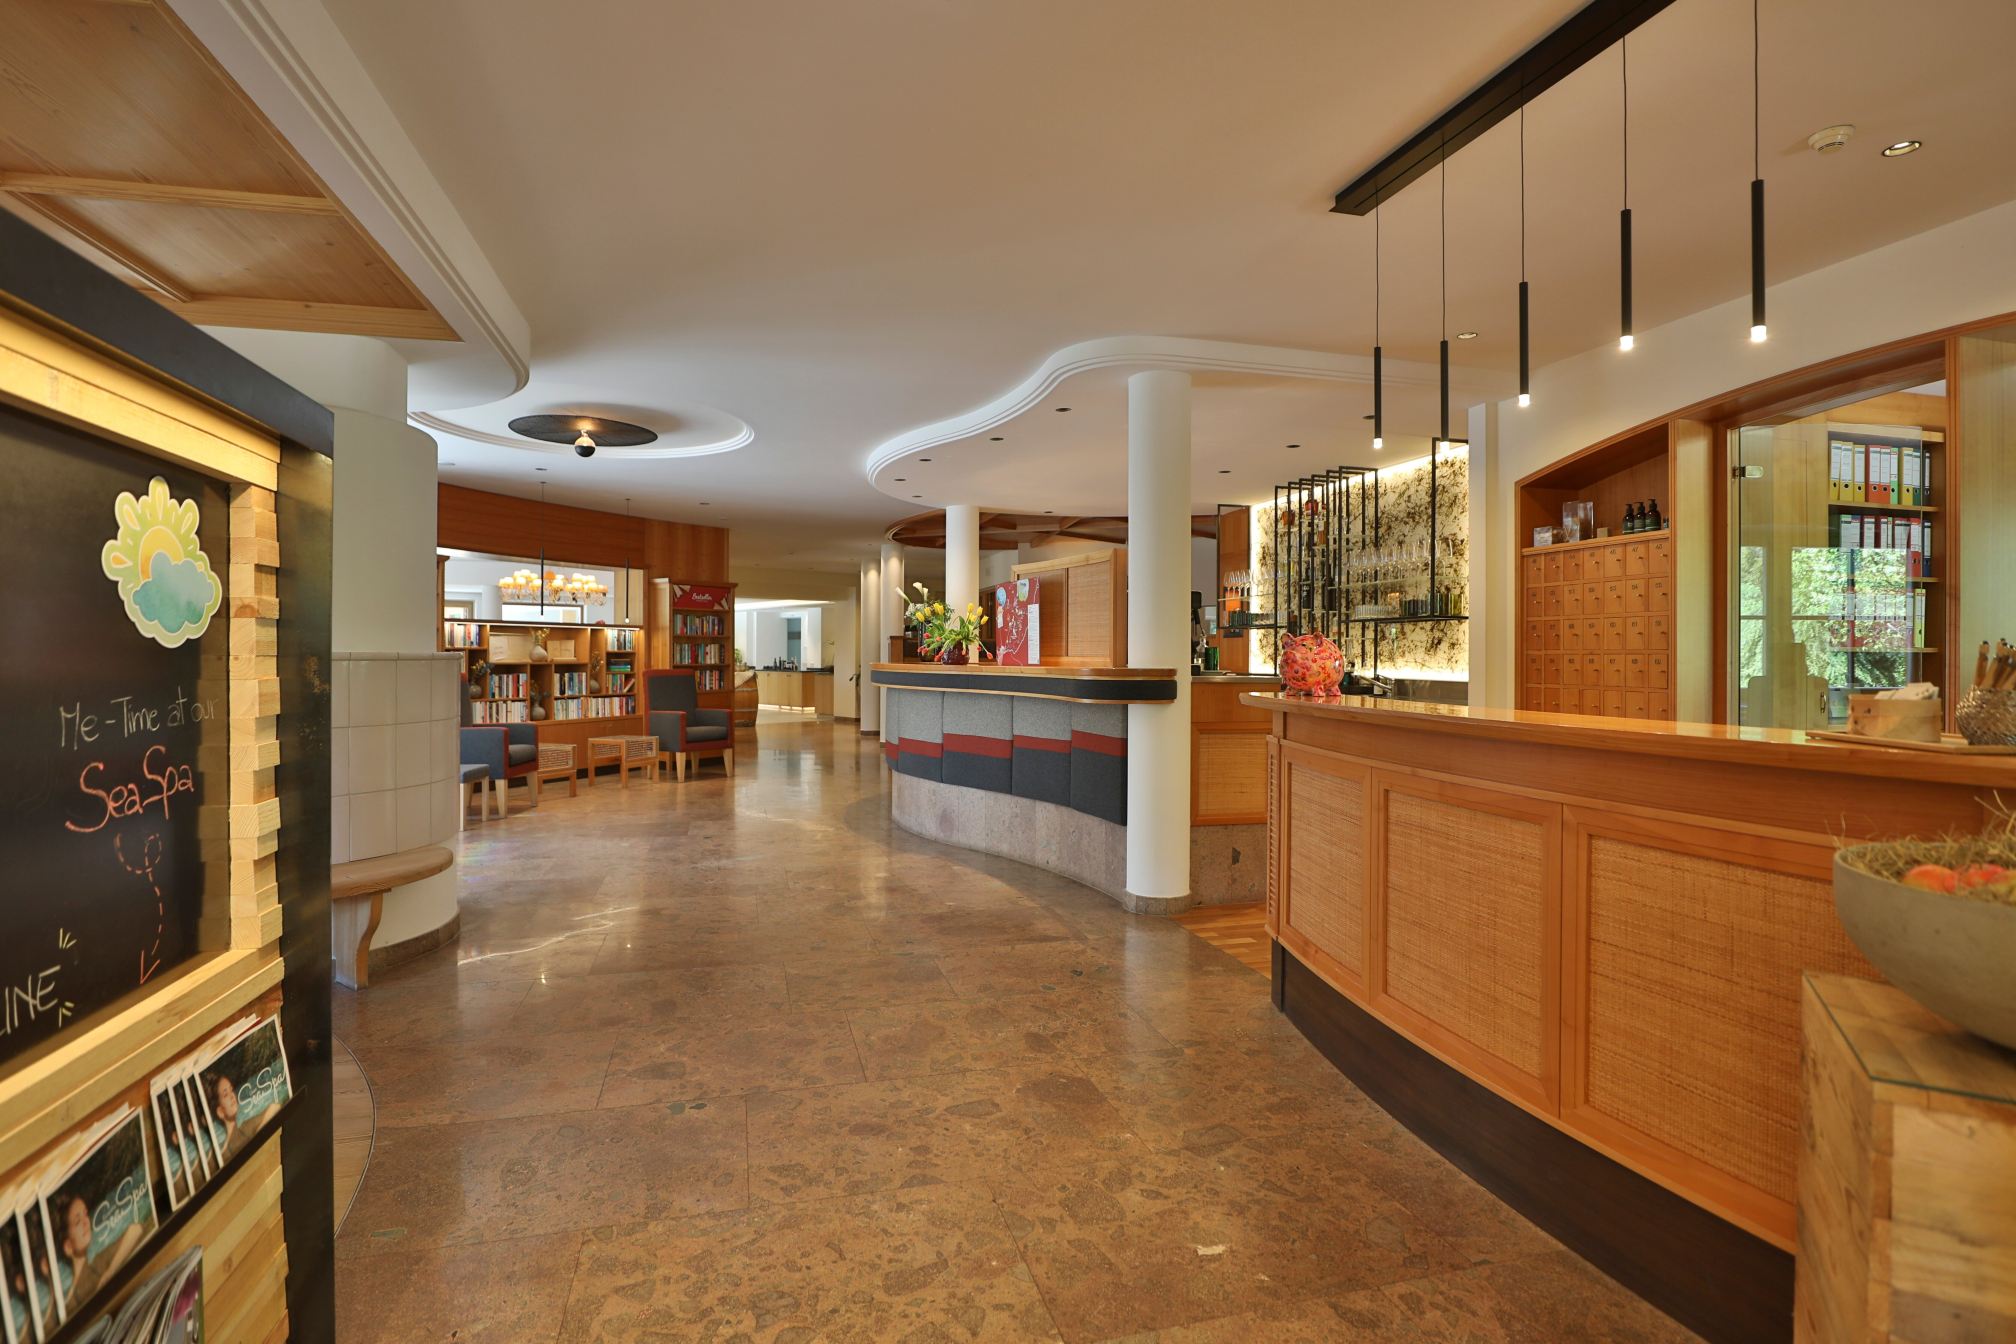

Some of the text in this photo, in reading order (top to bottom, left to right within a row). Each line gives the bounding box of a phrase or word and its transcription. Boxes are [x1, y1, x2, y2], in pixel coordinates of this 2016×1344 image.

[167, 685, 188, 726] at
[190, 698, 219, 722] our
[0, 965, 61, 1035] INE
